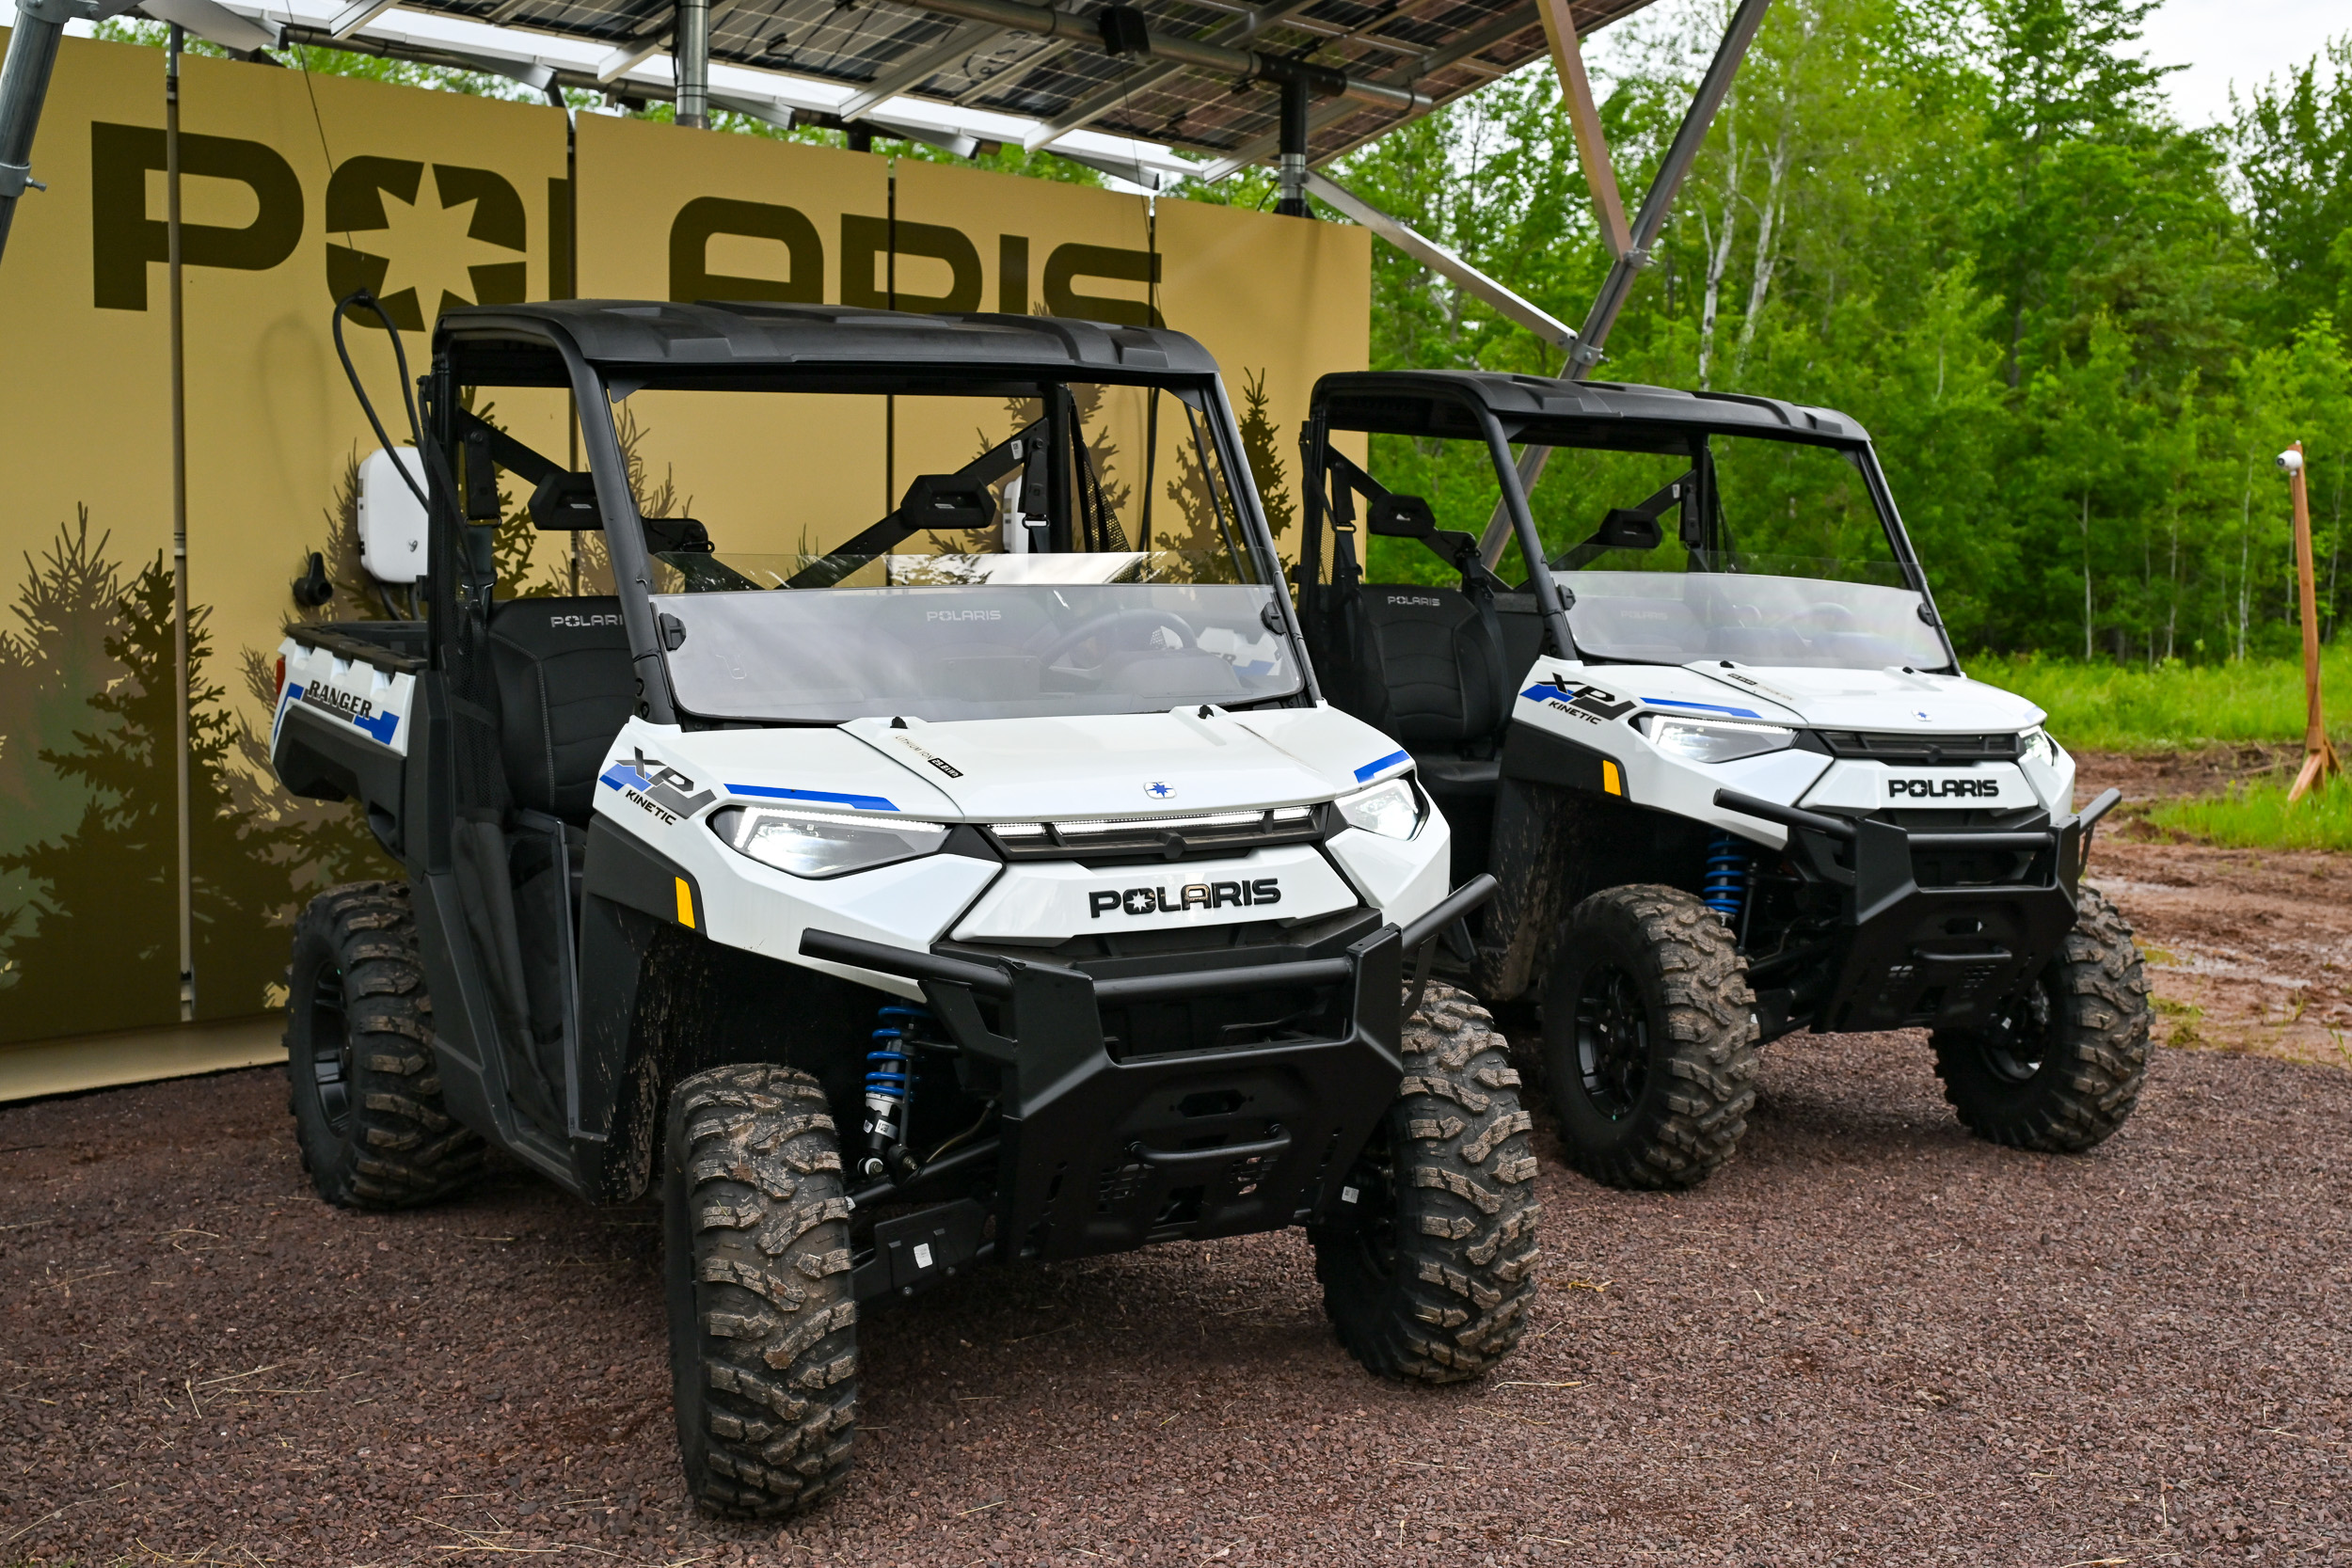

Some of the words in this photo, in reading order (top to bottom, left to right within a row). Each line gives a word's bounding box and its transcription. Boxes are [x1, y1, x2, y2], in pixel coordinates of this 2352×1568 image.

[1387, 595, 1441, 607] POLARIS
[549, 613, 624, 628] POLARI
[926, 610, 1002, 622] POLARIS
[307, 679, 373, 720] RANGER
[1548, 700, 1603, 725] KINETIC
[1887, 779, 2000, 799] POLARIS
[625, 789, 678, 826] KINETIC
[1088, 877, 1282, 919] POLARIS
